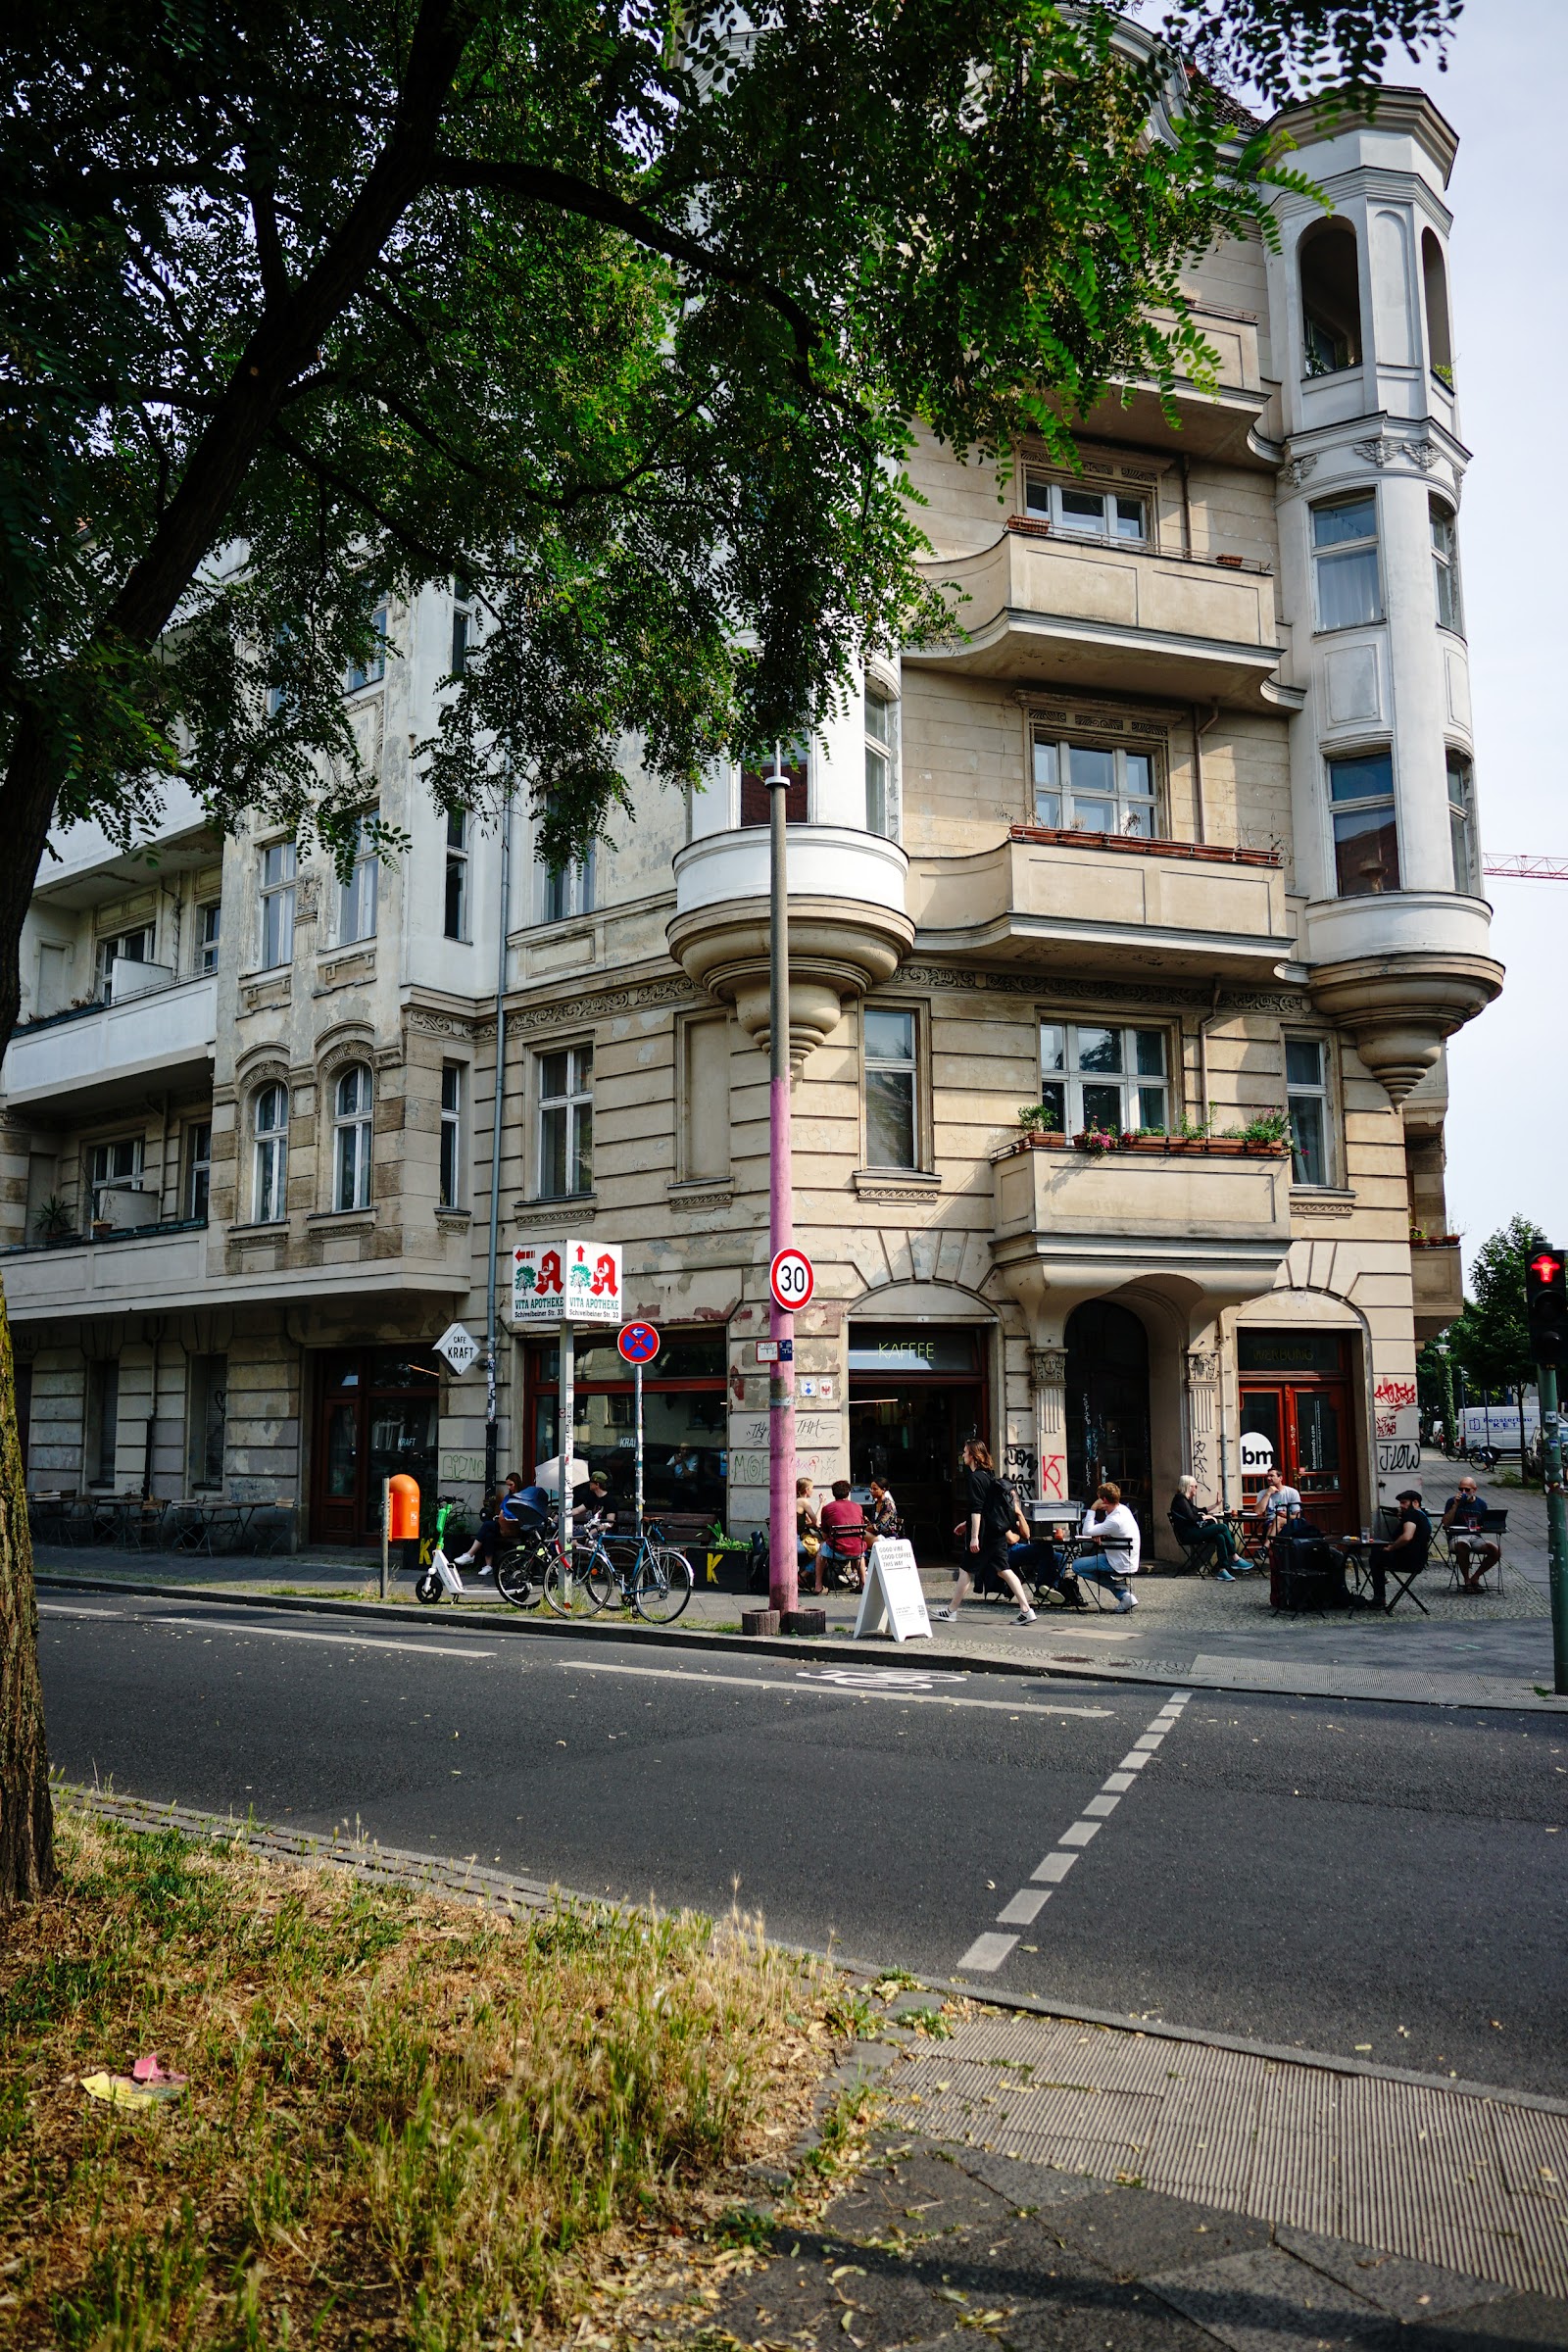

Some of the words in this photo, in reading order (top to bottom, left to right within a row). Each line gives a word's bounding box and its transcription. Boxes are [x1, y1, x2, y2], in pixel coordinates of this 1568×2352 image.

[780, 1265, 805, 1293] 30
[514, 1298, 529, 1309] VITA
[530, 1297, 564, 1308] APOTHEKE
[569, 1297, 584, 1307] VITA
[586, 1298, 618, 1309] APOTHEKE
[448, 1347, 473, 1359] KRAFT
[878, 1342, 934, 1359] KAFFEE
[1253, 1348, 1314, 1361] WERBUNG
[398, 1438, 416, 1447] KRAFT
[619, 1437, 636, 1447] KRA
[1242, 1446, 1274, 1465] bm
[418, 1538, 433, 1565] K
[707, 1552, 724, 1585] K
